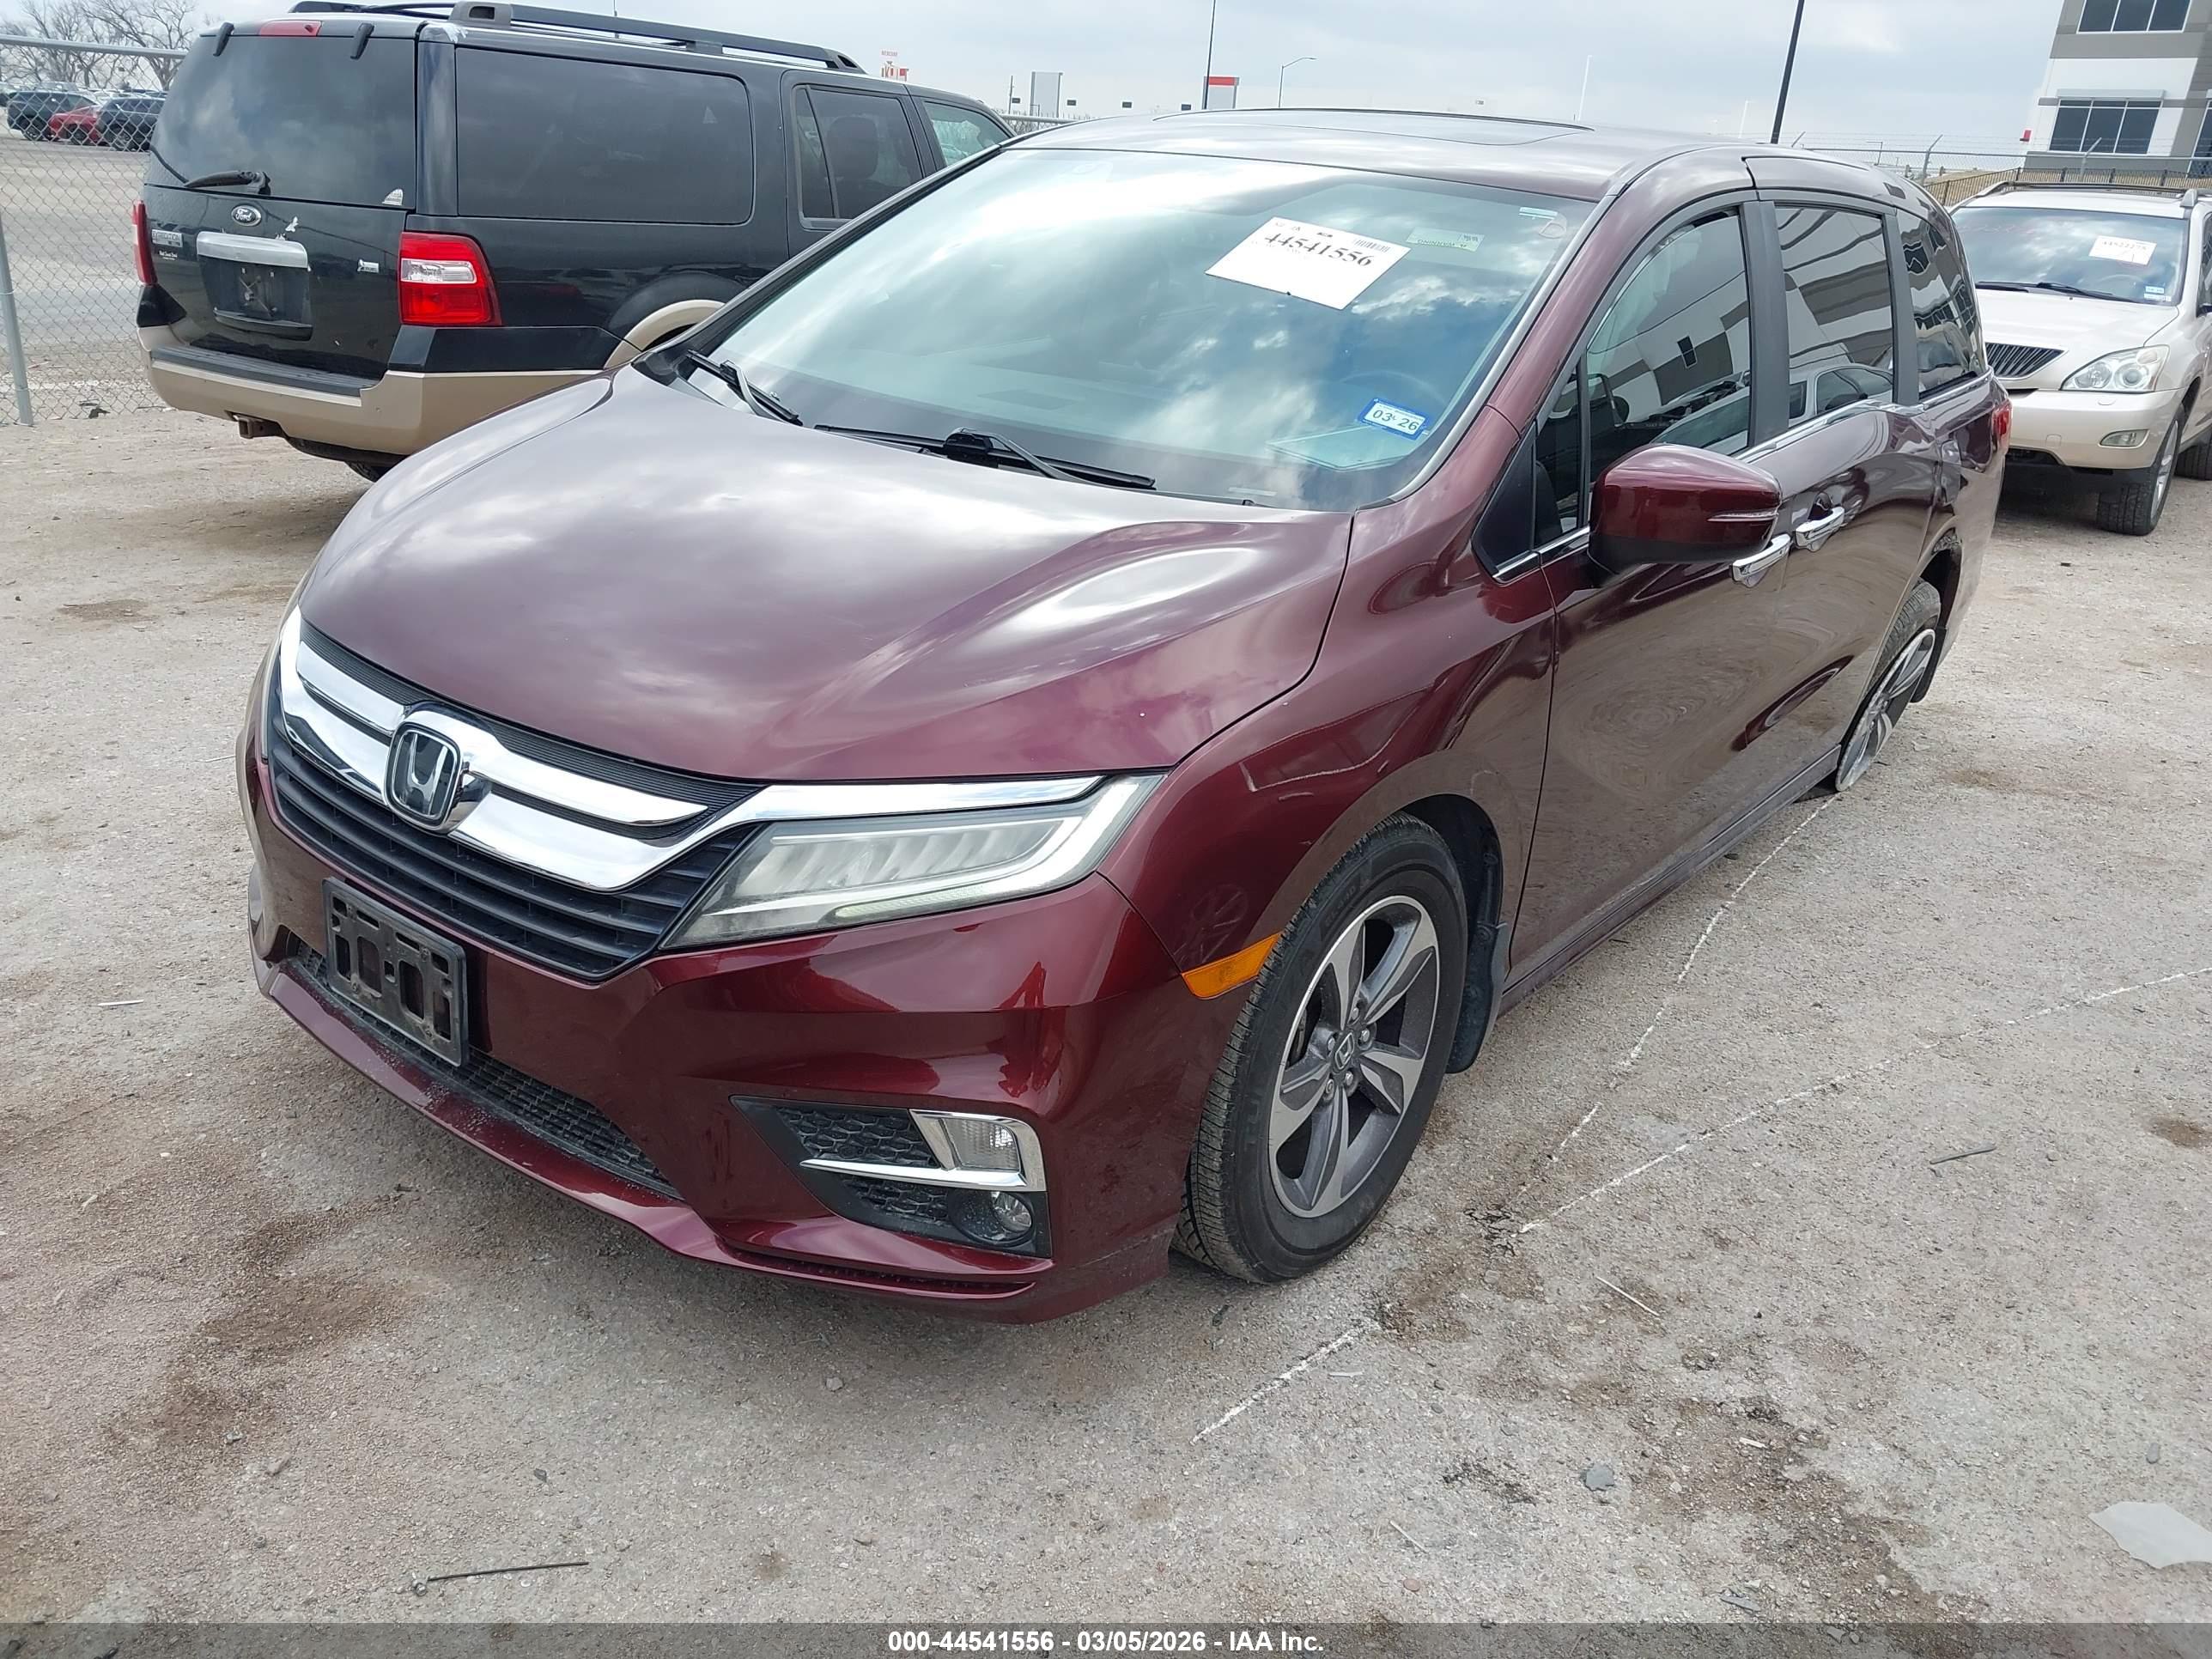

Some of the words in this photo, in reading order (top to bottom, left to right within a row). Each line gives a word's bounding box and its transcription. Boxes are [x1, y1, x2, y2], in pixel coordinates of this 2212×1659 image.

[235, 208, 252, 222] Ford
[1264, 233, 1375, 267] 44541556
[1372, 409, 1394, 422] 03
[1397, 417, 1420, 431] 26
